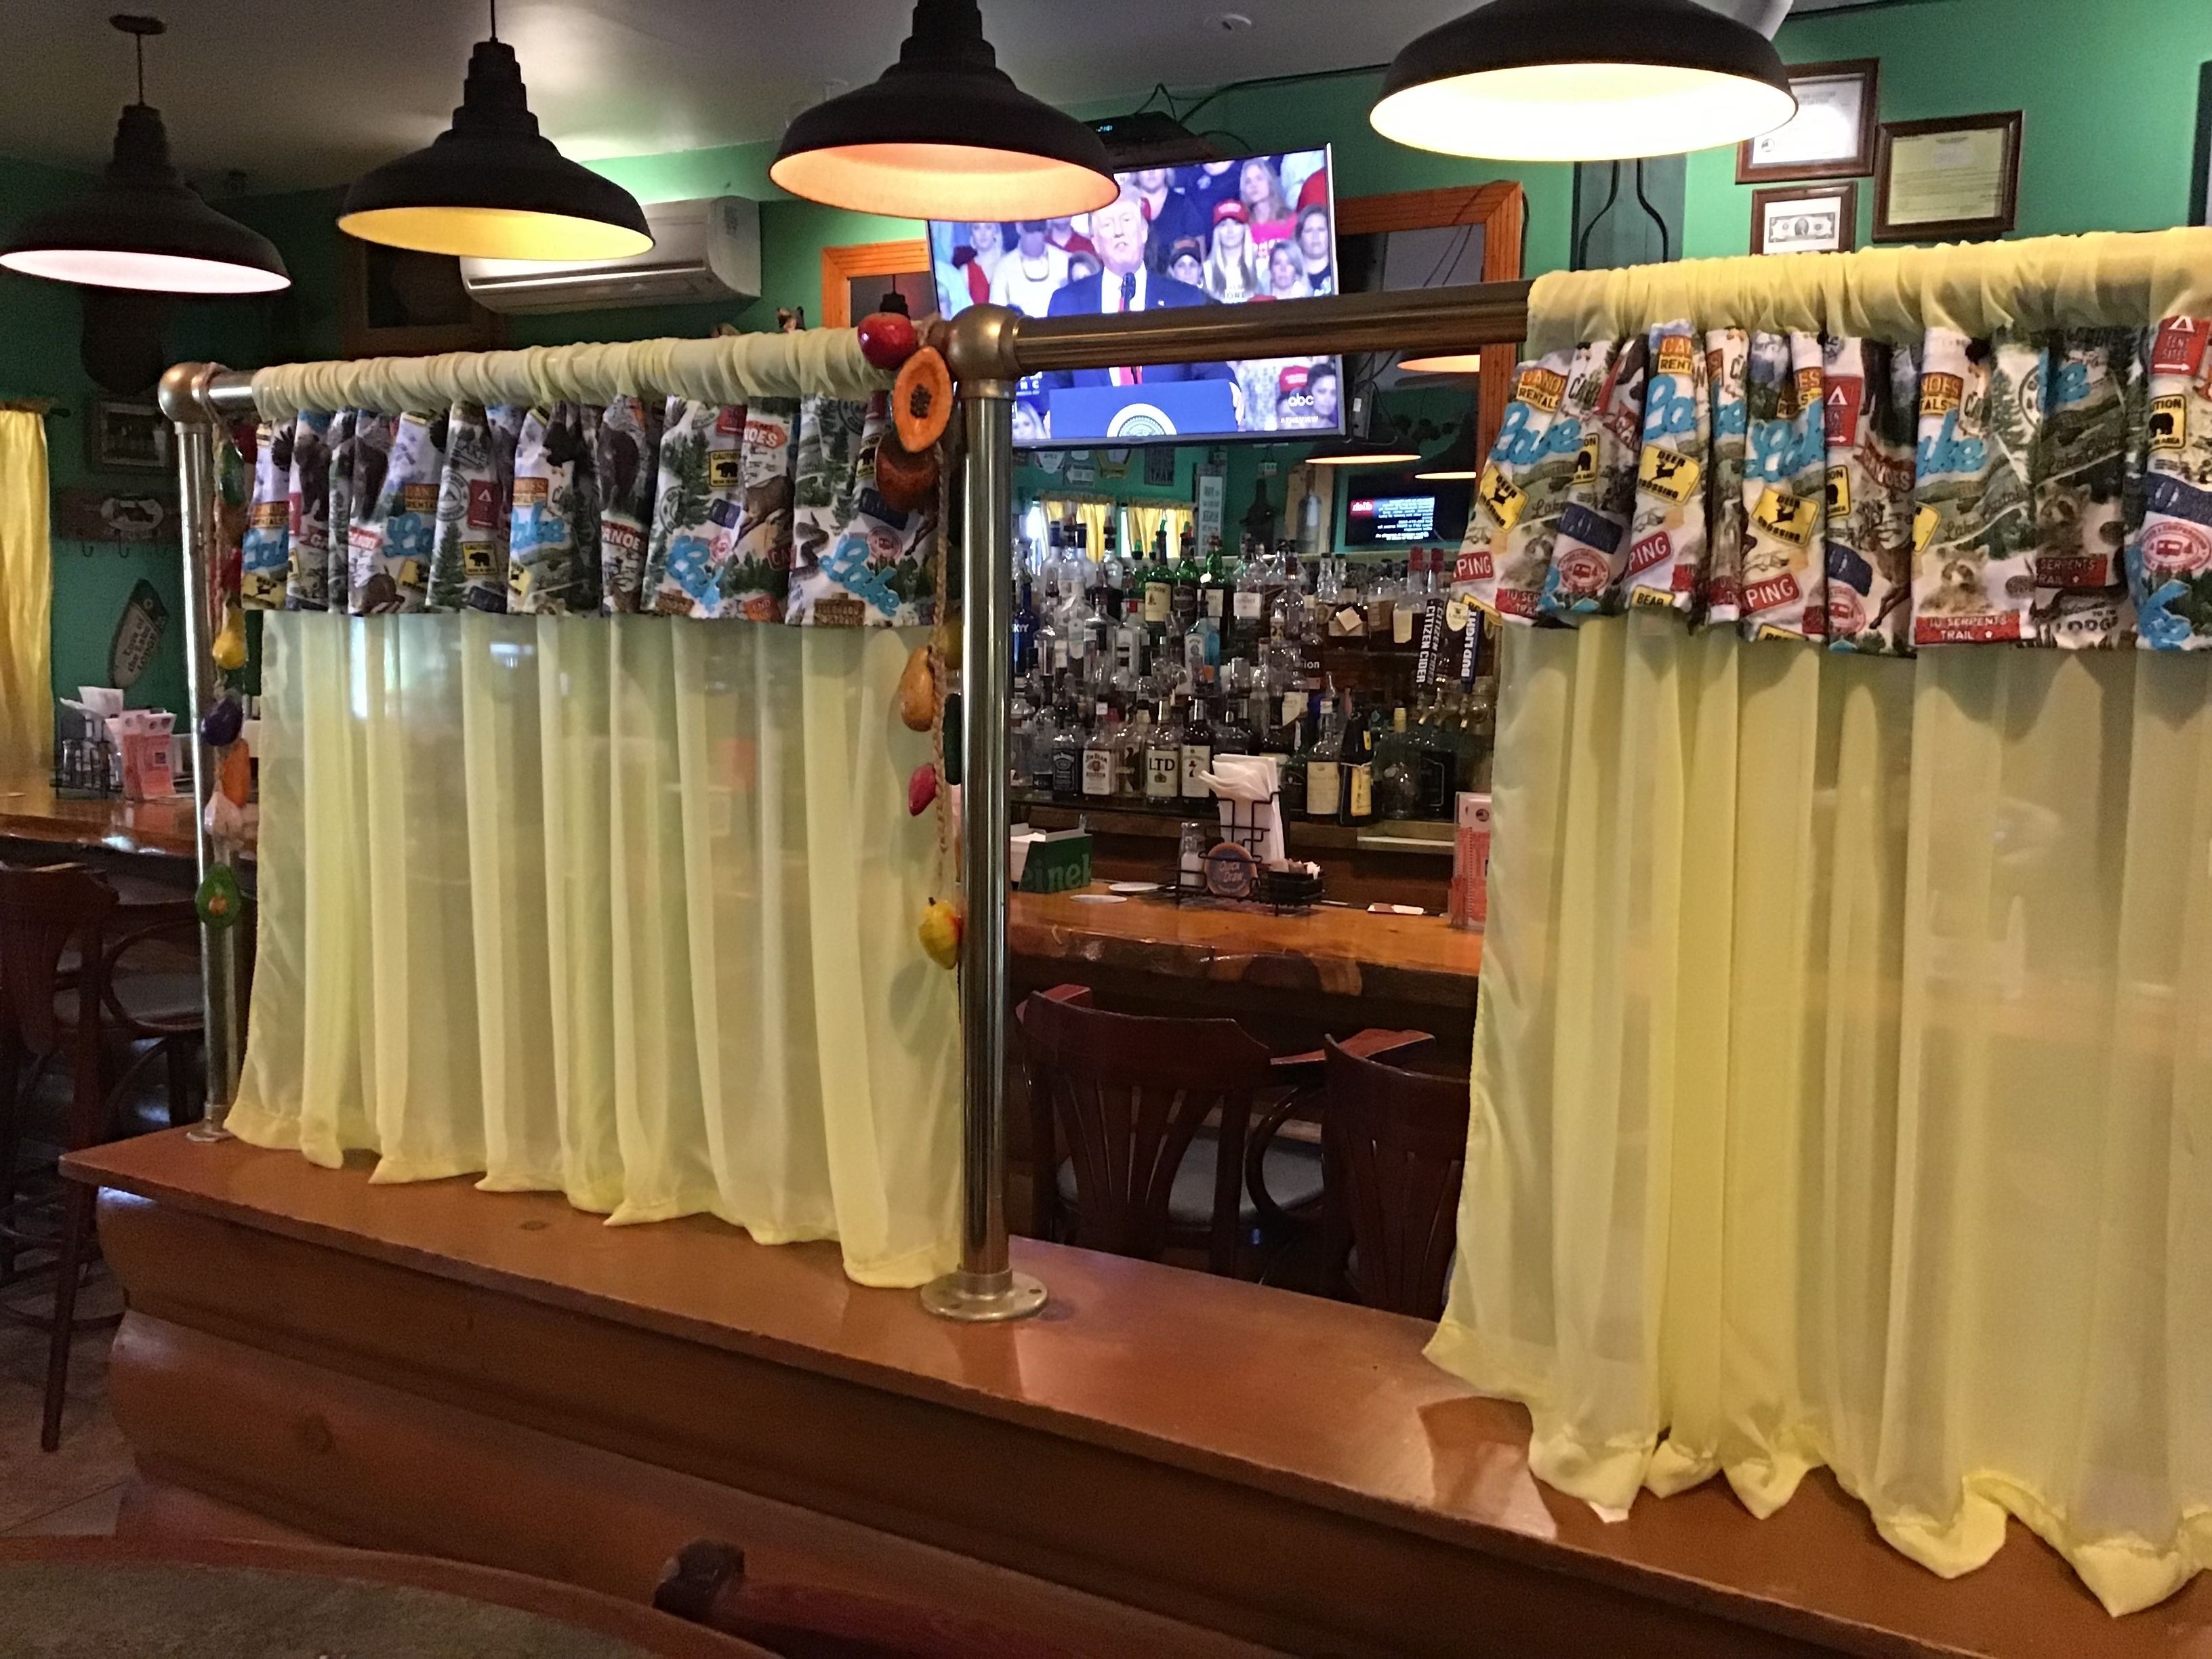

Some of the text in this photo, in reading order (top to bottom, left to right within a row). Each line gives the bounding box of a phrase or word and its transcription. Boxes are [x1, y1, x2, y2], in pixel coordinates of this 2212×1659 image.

[1288, 392, 1314, 407] abc
[1657, 451, 1685, 467] DEER
[1776, 494, 1801, 510] DEER
[1464, 610, 1477, 648] LIGHT
[1947, 615, 2008, 627] SERPENTS
[1940, 629, 1974, 640] TRAIL
[1416, 605, 1436, 683] CITIZEN CIDER
[1427, 607, 1443, 685] CITIZEN CIDER
[1461, 649, 1473, 677] BUD
[1149, 757, 1176, 771] LTD
